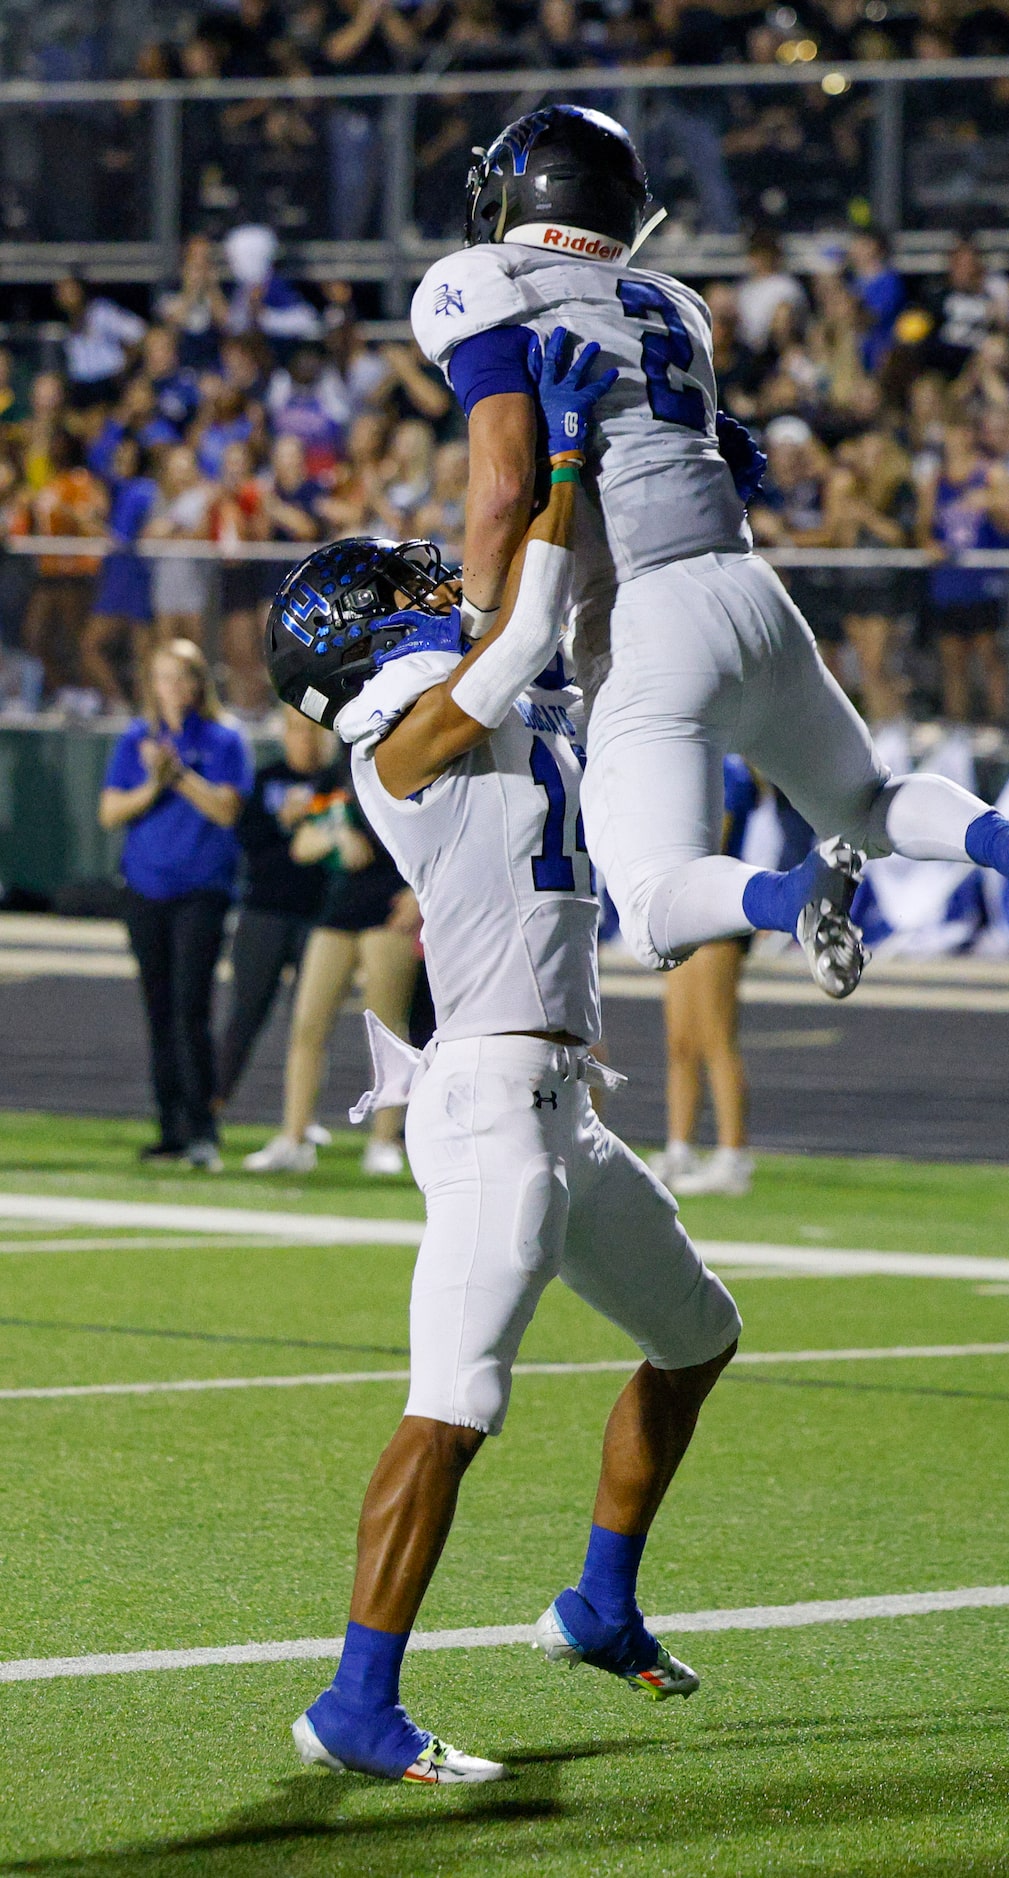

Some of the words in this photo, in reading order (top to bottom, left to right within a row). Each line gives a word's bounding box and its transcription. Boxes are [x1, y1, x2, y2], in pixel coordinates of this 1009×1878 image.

[543, 227, 623, 261] Riddell
[615, 278, 708, 437] 2
[281, 581, 331, 648] 14
[528, 734, 598, 896] 1
